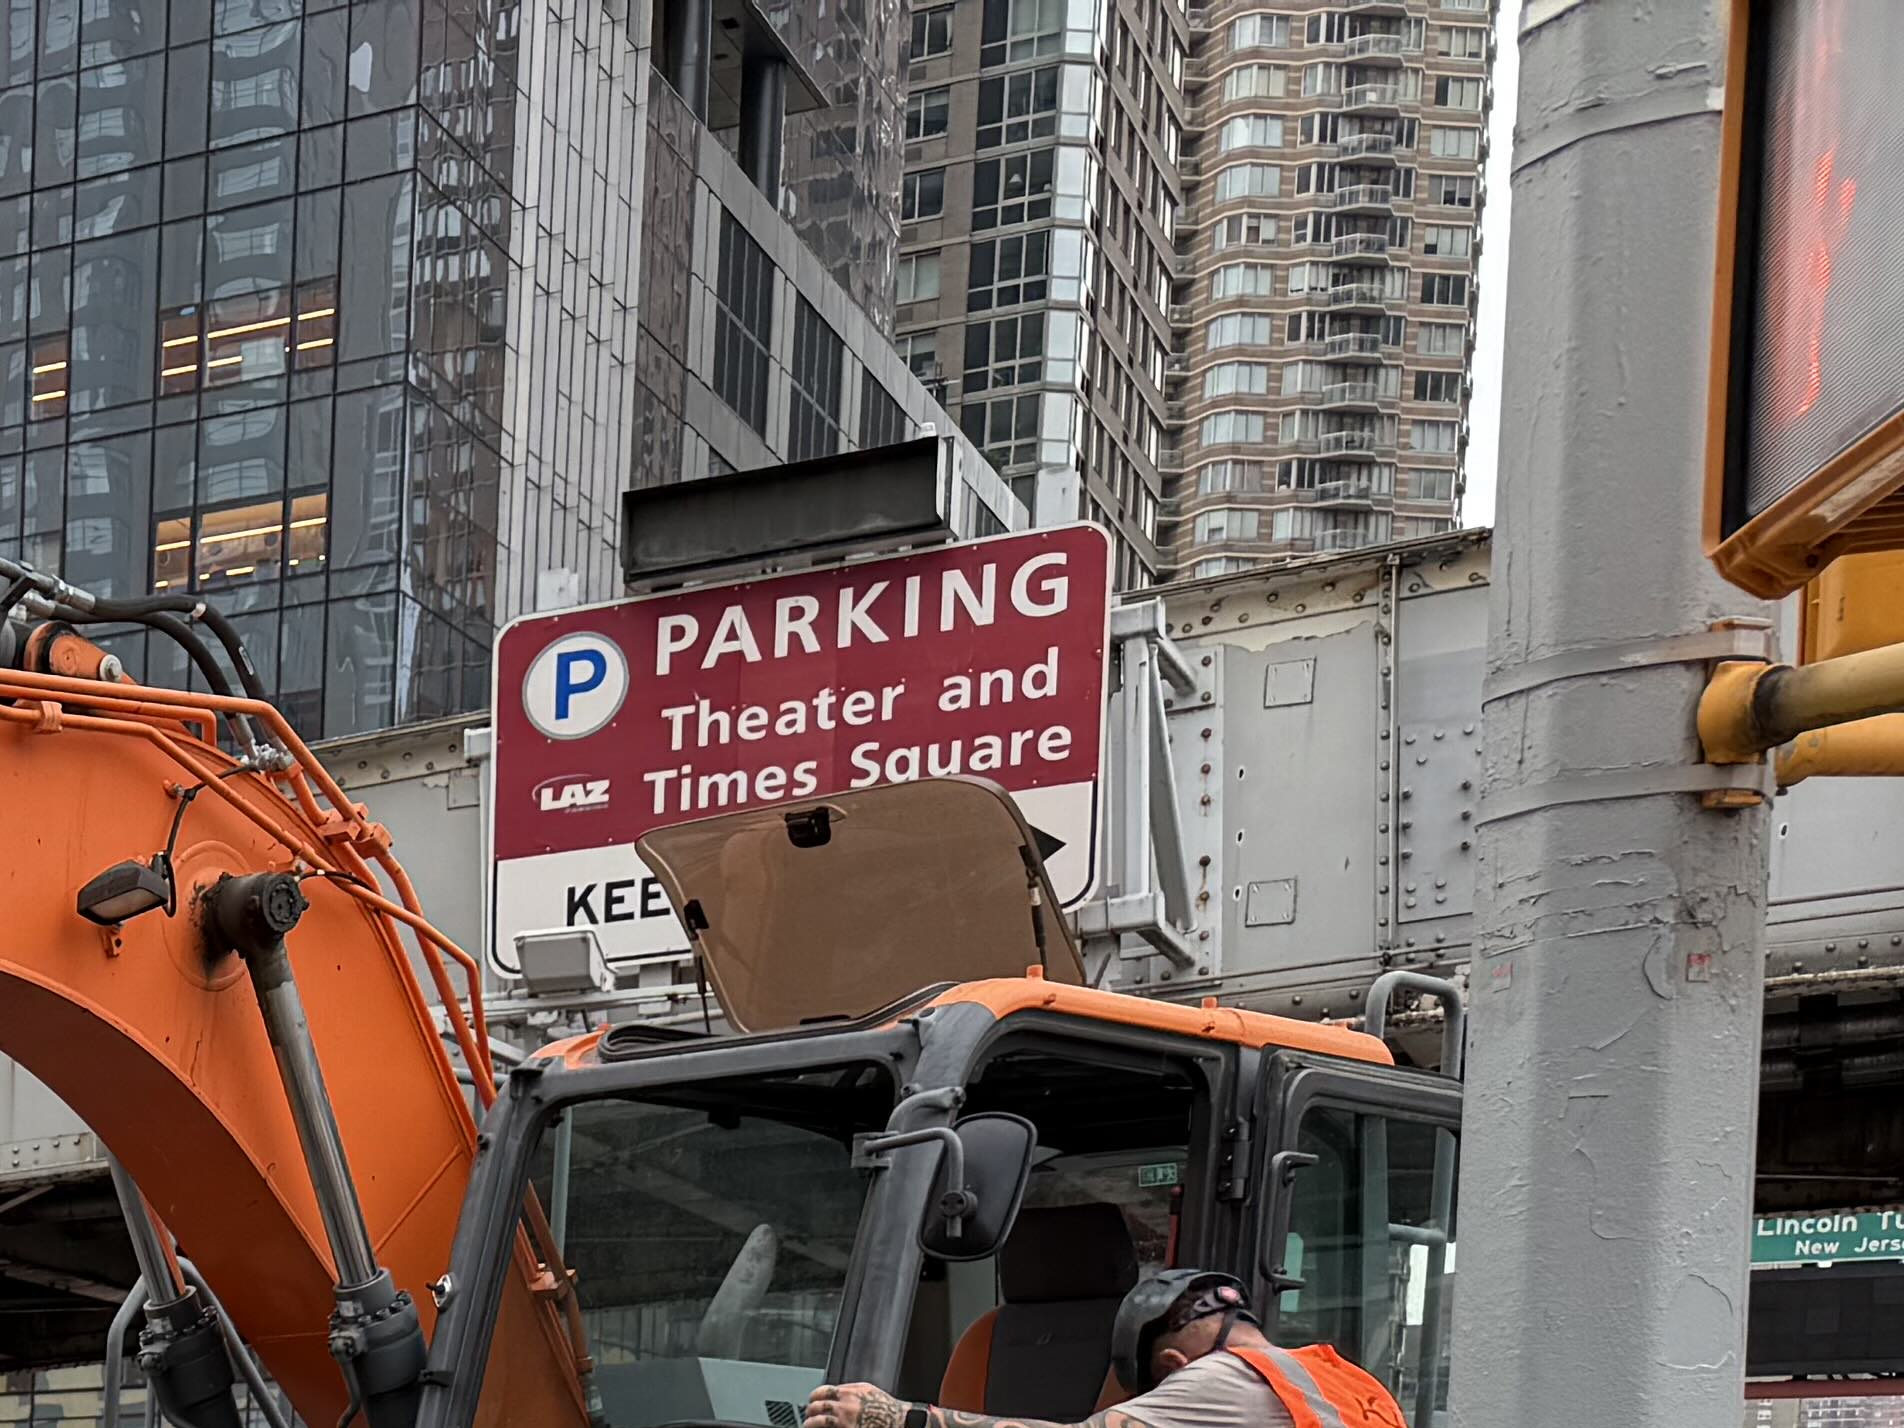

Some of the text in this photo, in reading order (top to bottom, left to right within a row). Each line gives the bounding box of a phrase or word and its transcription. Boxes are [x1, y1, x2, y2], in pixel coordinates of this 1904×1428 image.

[655, 552, 1070, 676] PARKING
[662, 647, 1060, 751] Theater and
[540, 779, 610, 811] LAZ
[643, 725, 1073, 815] Times Square
[1757, 1214, 1858, 1236] Lincoln
[1795, 1236, 1904, 1256] New Jers
